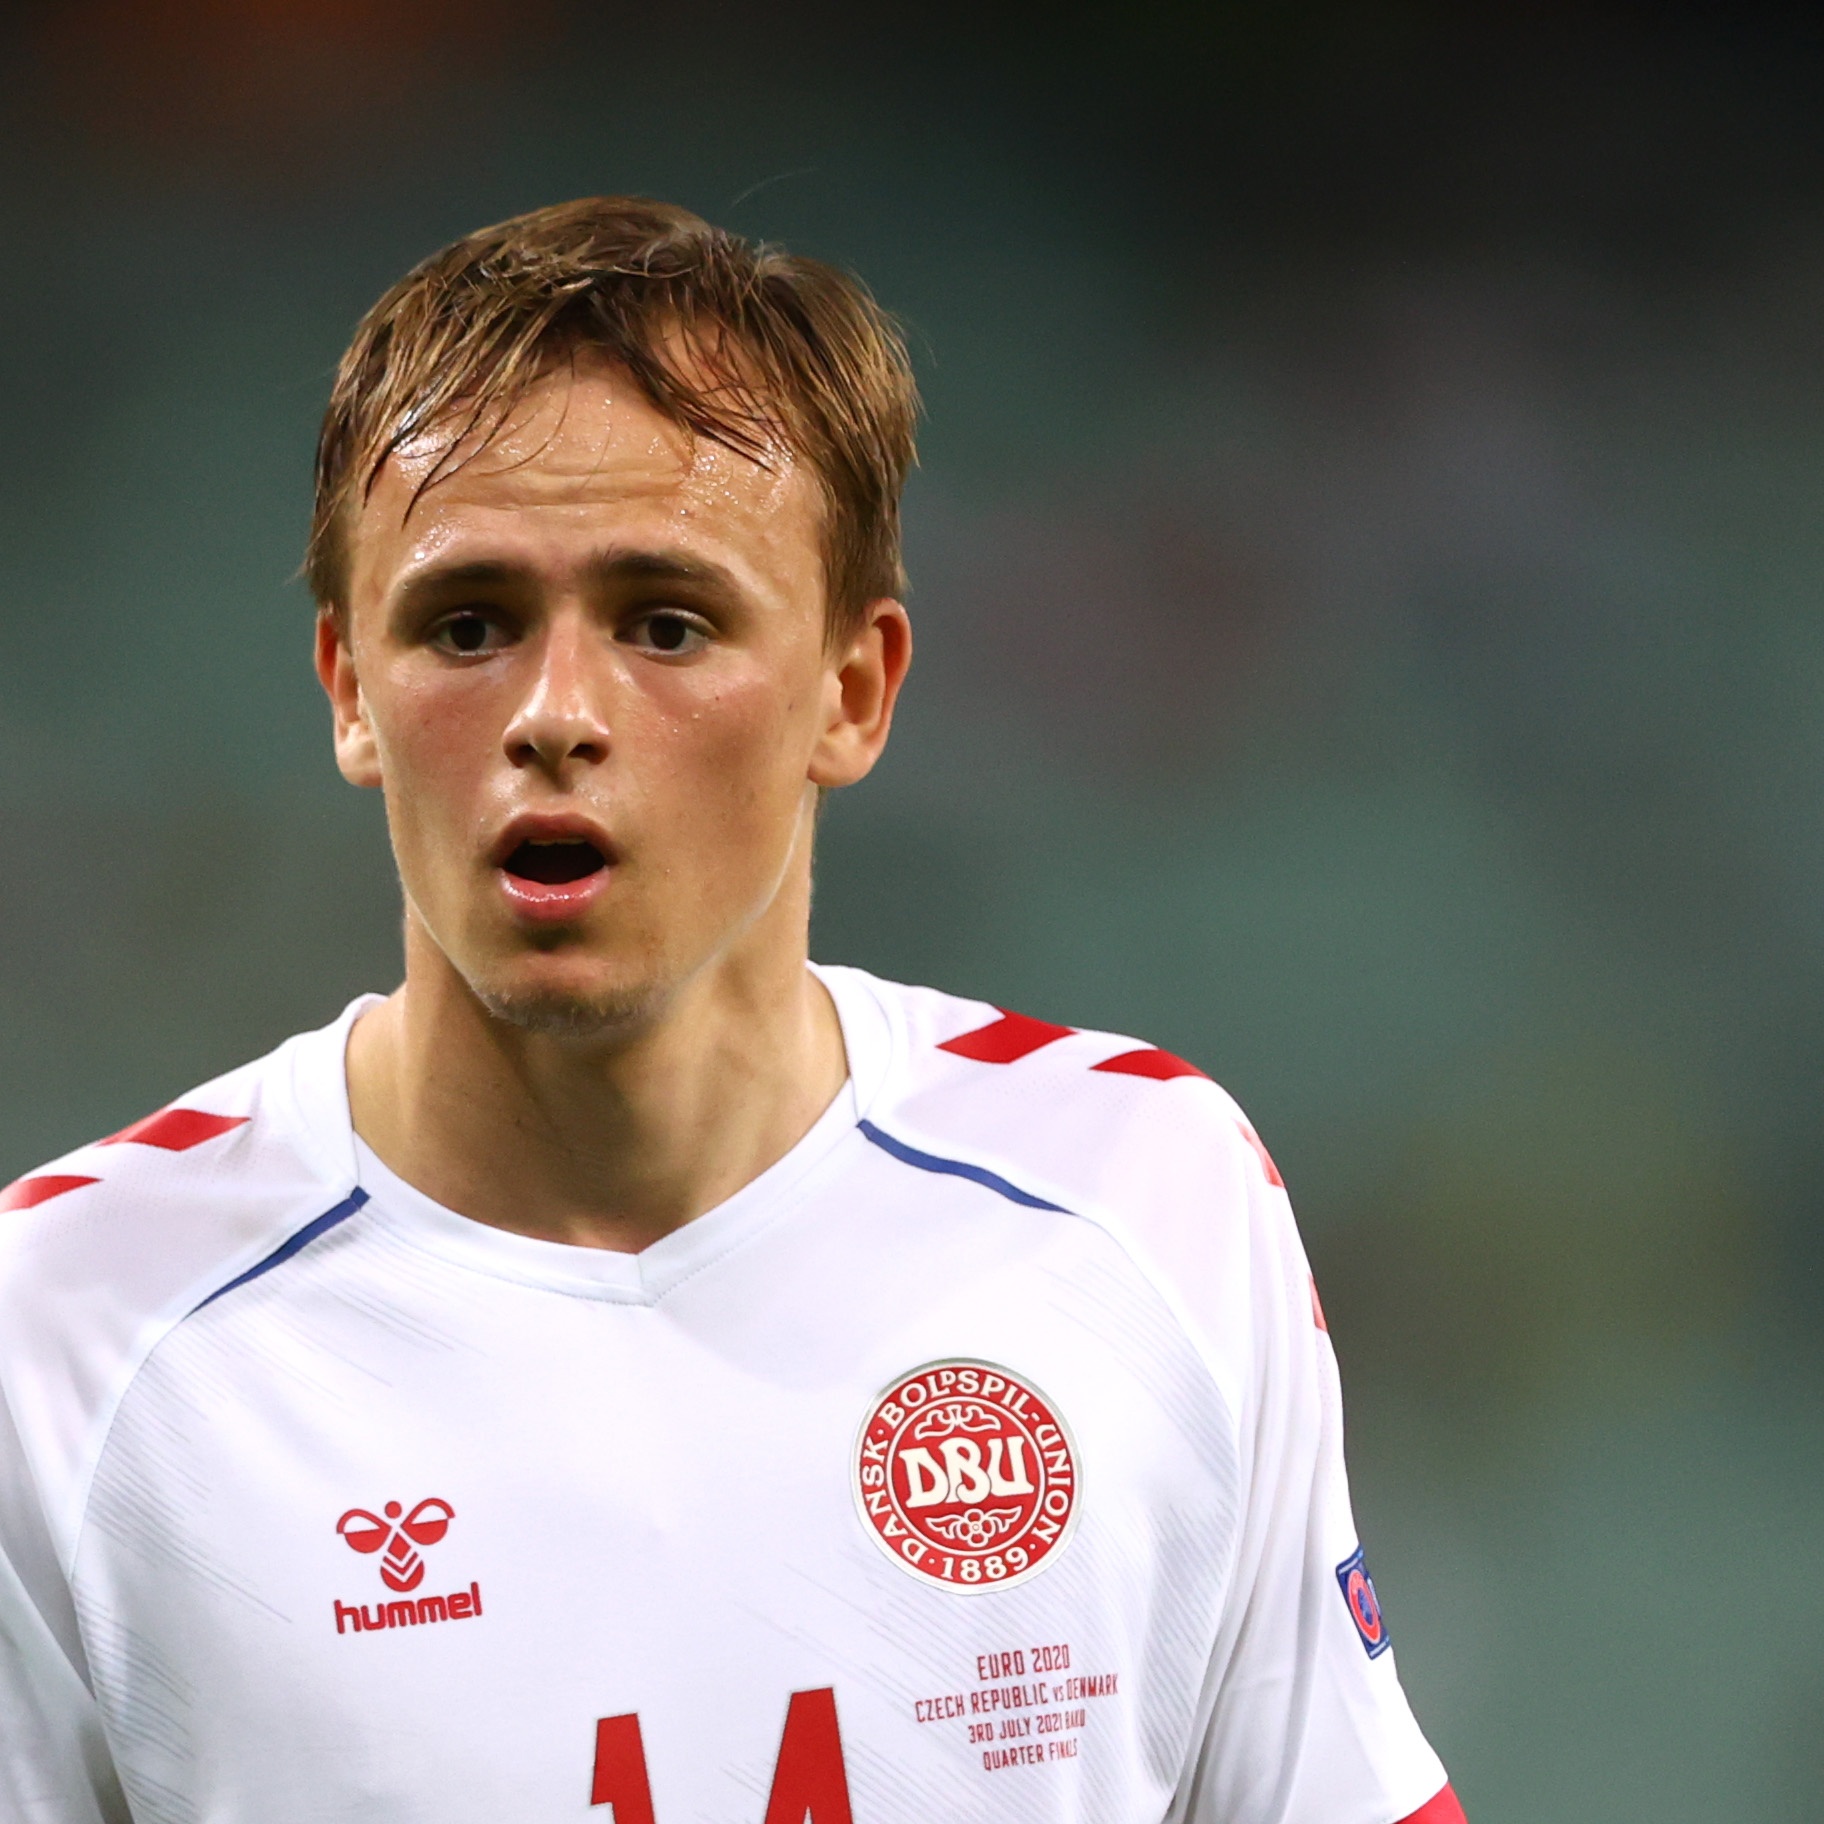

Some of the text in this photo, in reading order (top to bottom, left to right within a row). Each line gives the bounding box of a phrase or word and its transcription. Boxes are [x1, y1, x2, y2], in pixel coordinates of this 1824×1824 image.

[898, 1435, 1035, 1508] DBU
[861, 1436, 929, 1565] DANSK
[941, 1546, 1029, 1583] 1889
[333, 1581, 482, 1634] hummel
[976, 1644, 1071, 1681] EURO 2020
[914, 1695, 965, 1723] CZECH
[970, 1682, 1049, 1715] REPUBLIC
[1066, 1673, 1119, 1701] DENMARK
[968, 1722, 994, 1744] 3RD
[999, 1717, 1031, 1740] JULY
[1036, 1713, 1062, 1734] 2021
[983, 1744, 1045, 1772] QUARTER
